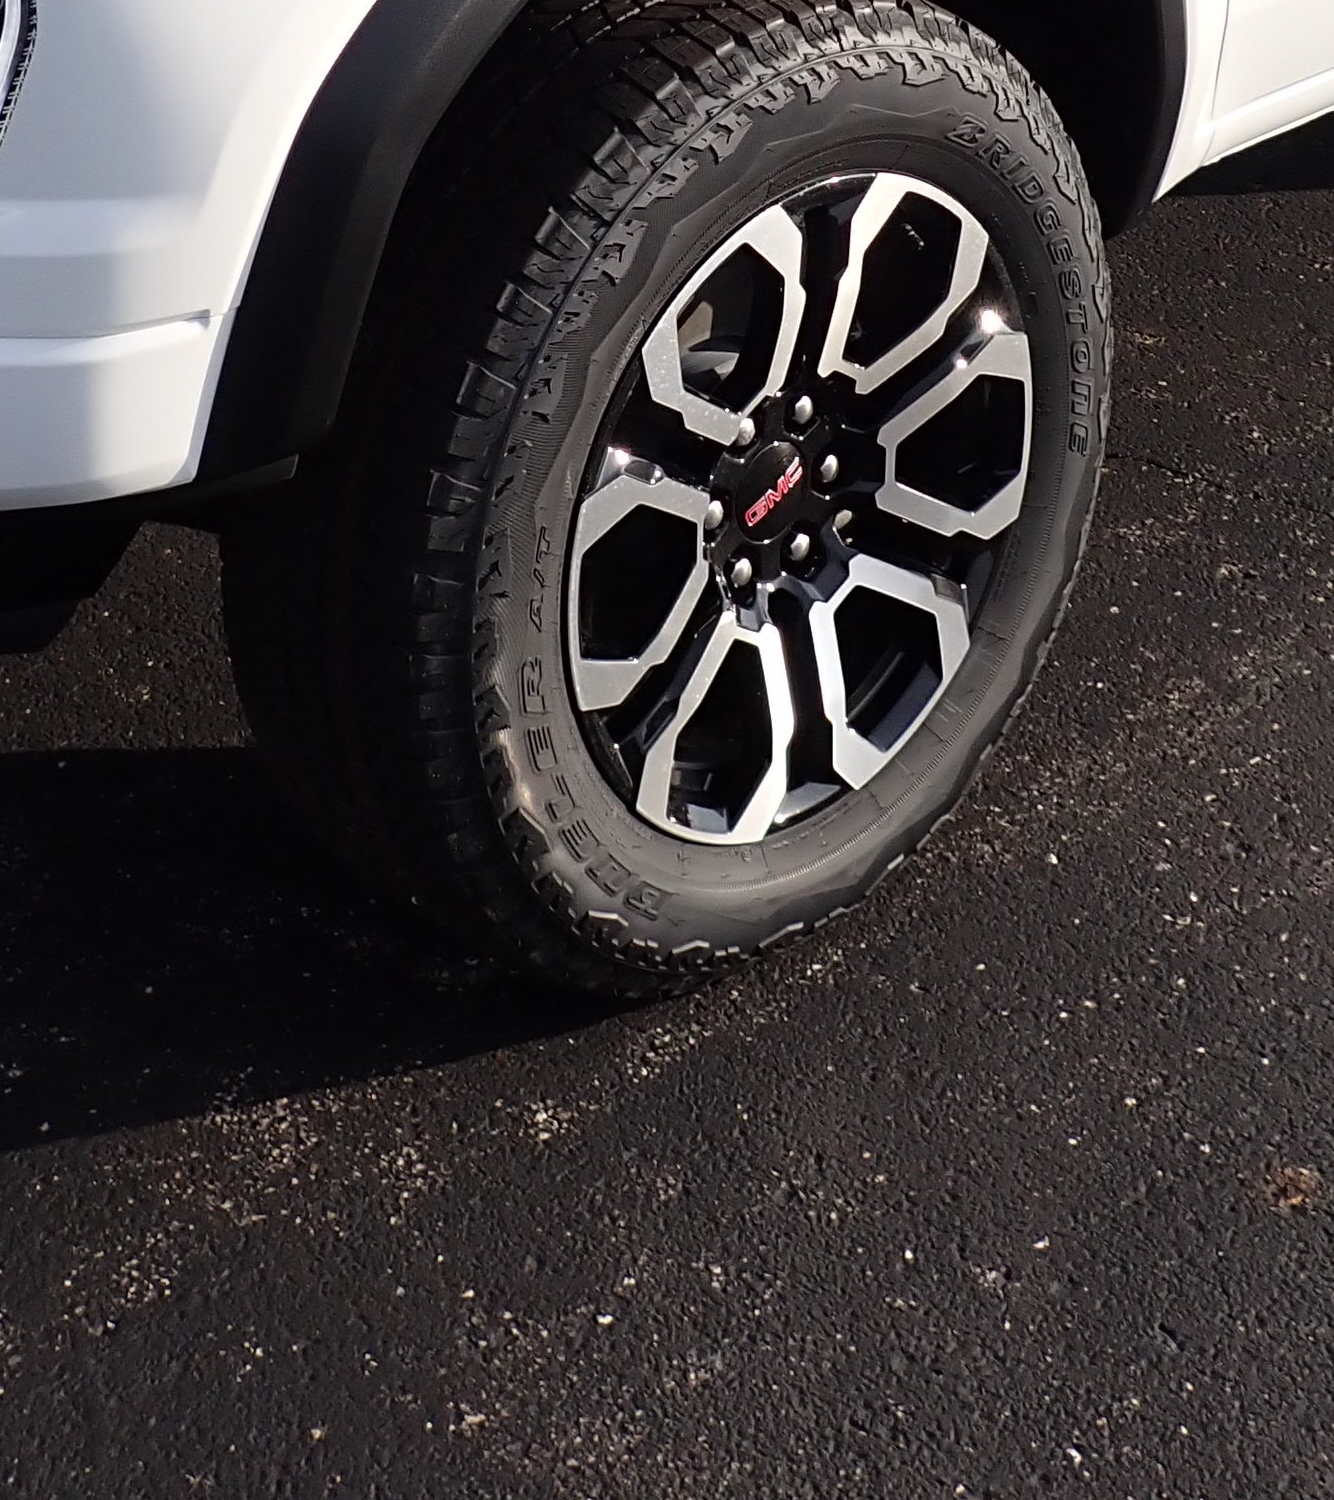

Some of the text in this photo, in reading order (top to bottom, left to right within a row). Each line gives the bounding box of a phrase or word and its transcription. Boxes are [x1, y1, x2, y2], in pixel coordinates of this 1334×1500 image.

[945, 113, 1094, 457] BRIDGESTONE
[745, 456, 803, 527] GMC
[521, 525, 672, 921] DUELER A/T
